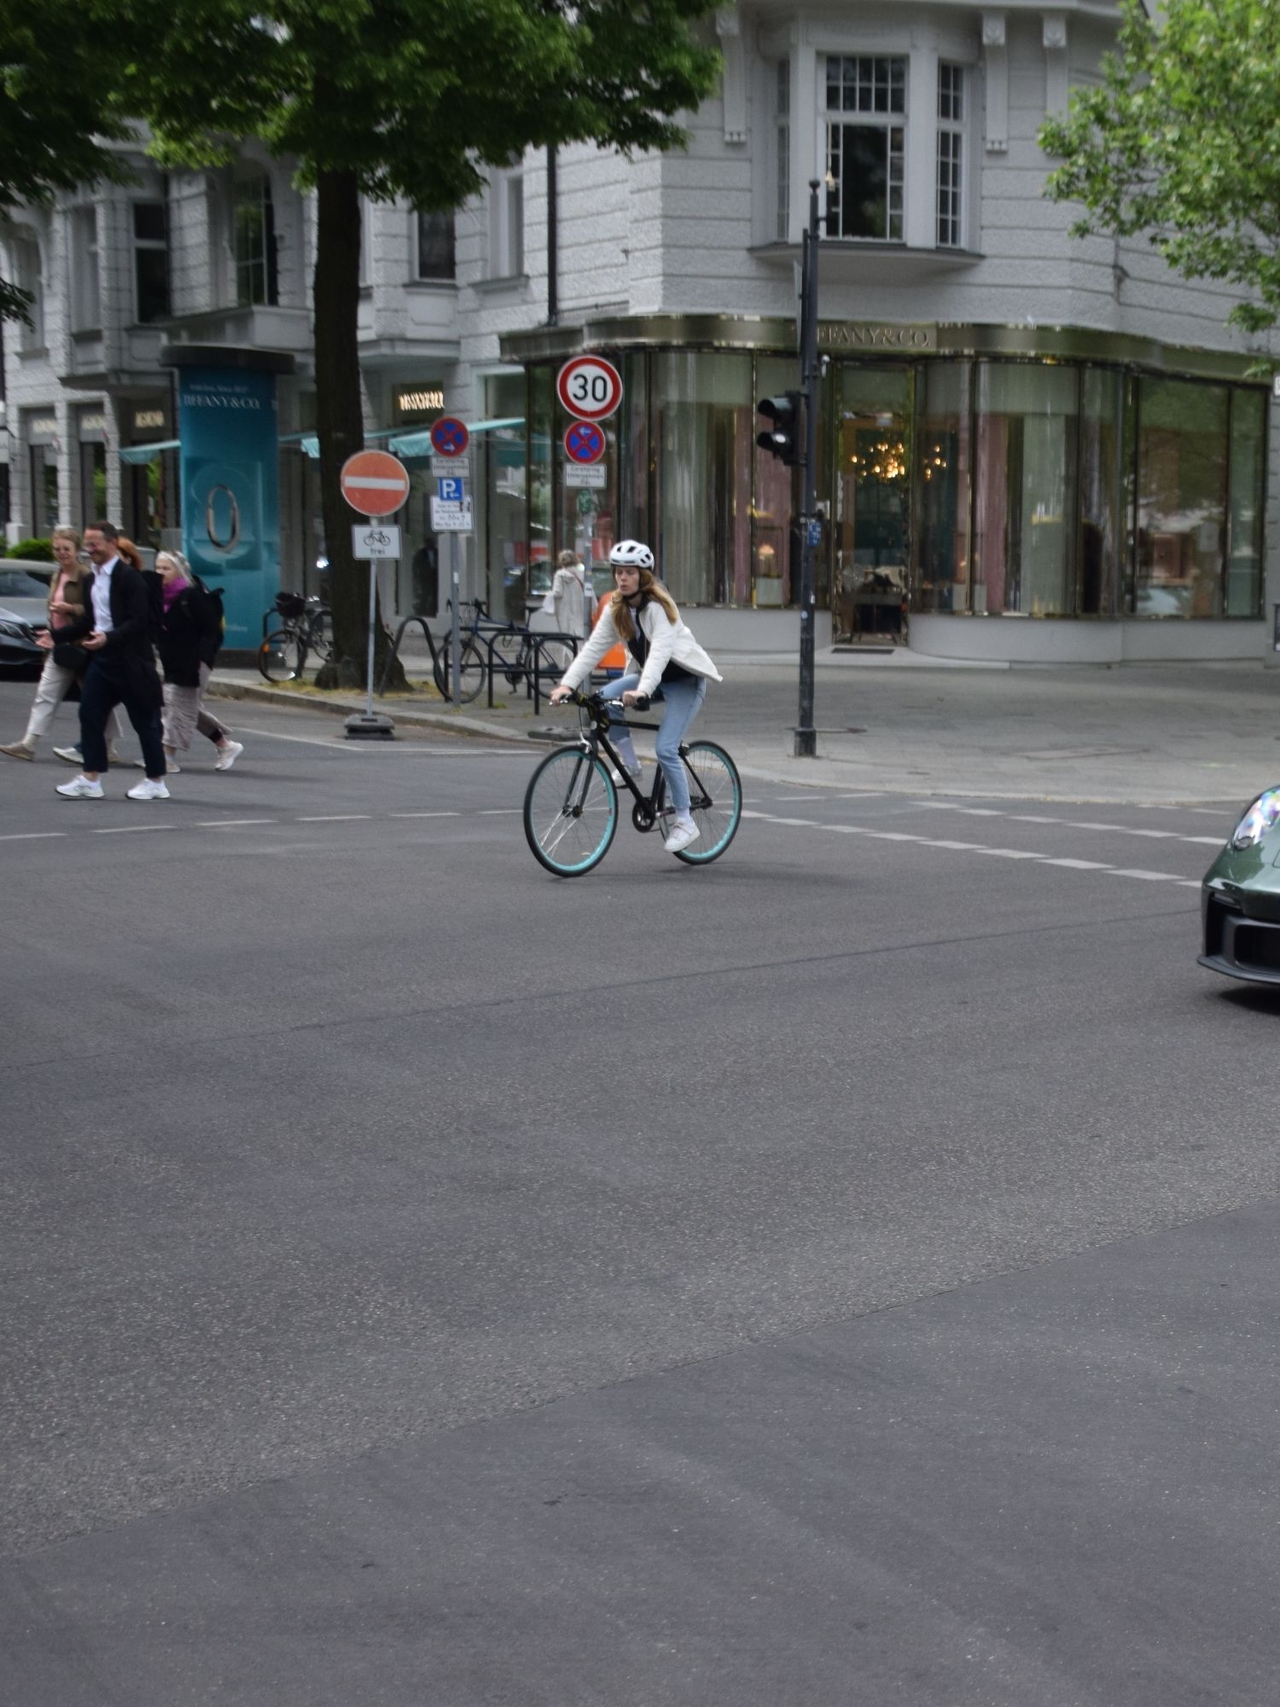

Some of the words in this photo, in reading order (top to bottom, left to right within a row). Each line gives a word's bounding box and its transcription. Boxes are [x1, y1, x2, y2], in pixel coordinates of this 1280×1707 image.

[816, 326, 931, 347] FFANY&CO.
[572, 374, 608, 402] 30
[442, 480, 456, 499] P
